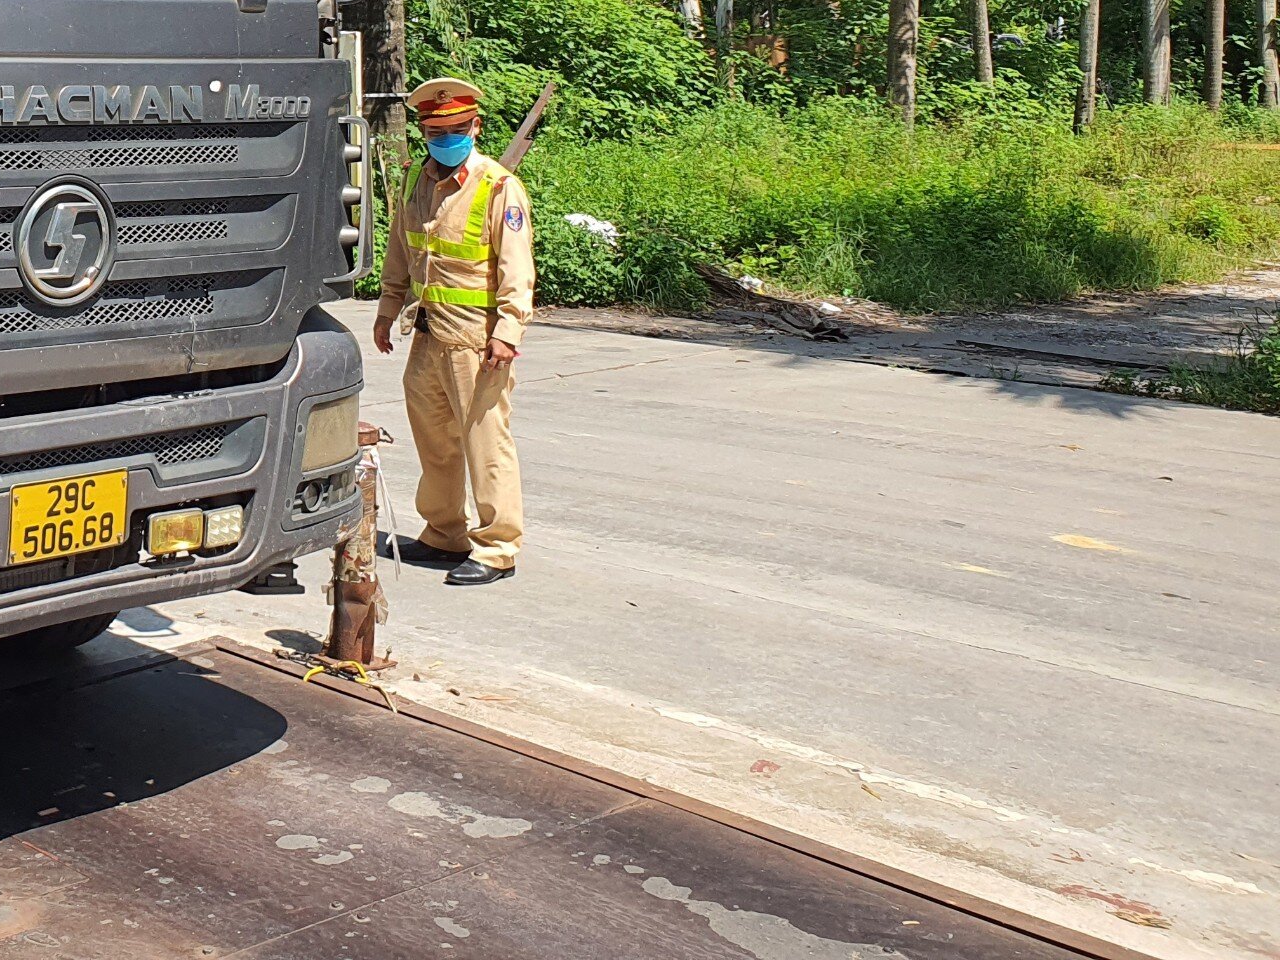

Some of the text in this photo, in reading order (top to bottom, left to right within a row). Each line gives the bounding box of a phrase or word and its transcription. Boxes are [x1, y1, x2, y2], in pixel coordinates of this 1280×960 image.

[224, 84, 312, 121] M3000
[46, 479, 96, 517] 29C
[23, 512, 113, 558] 506.68
